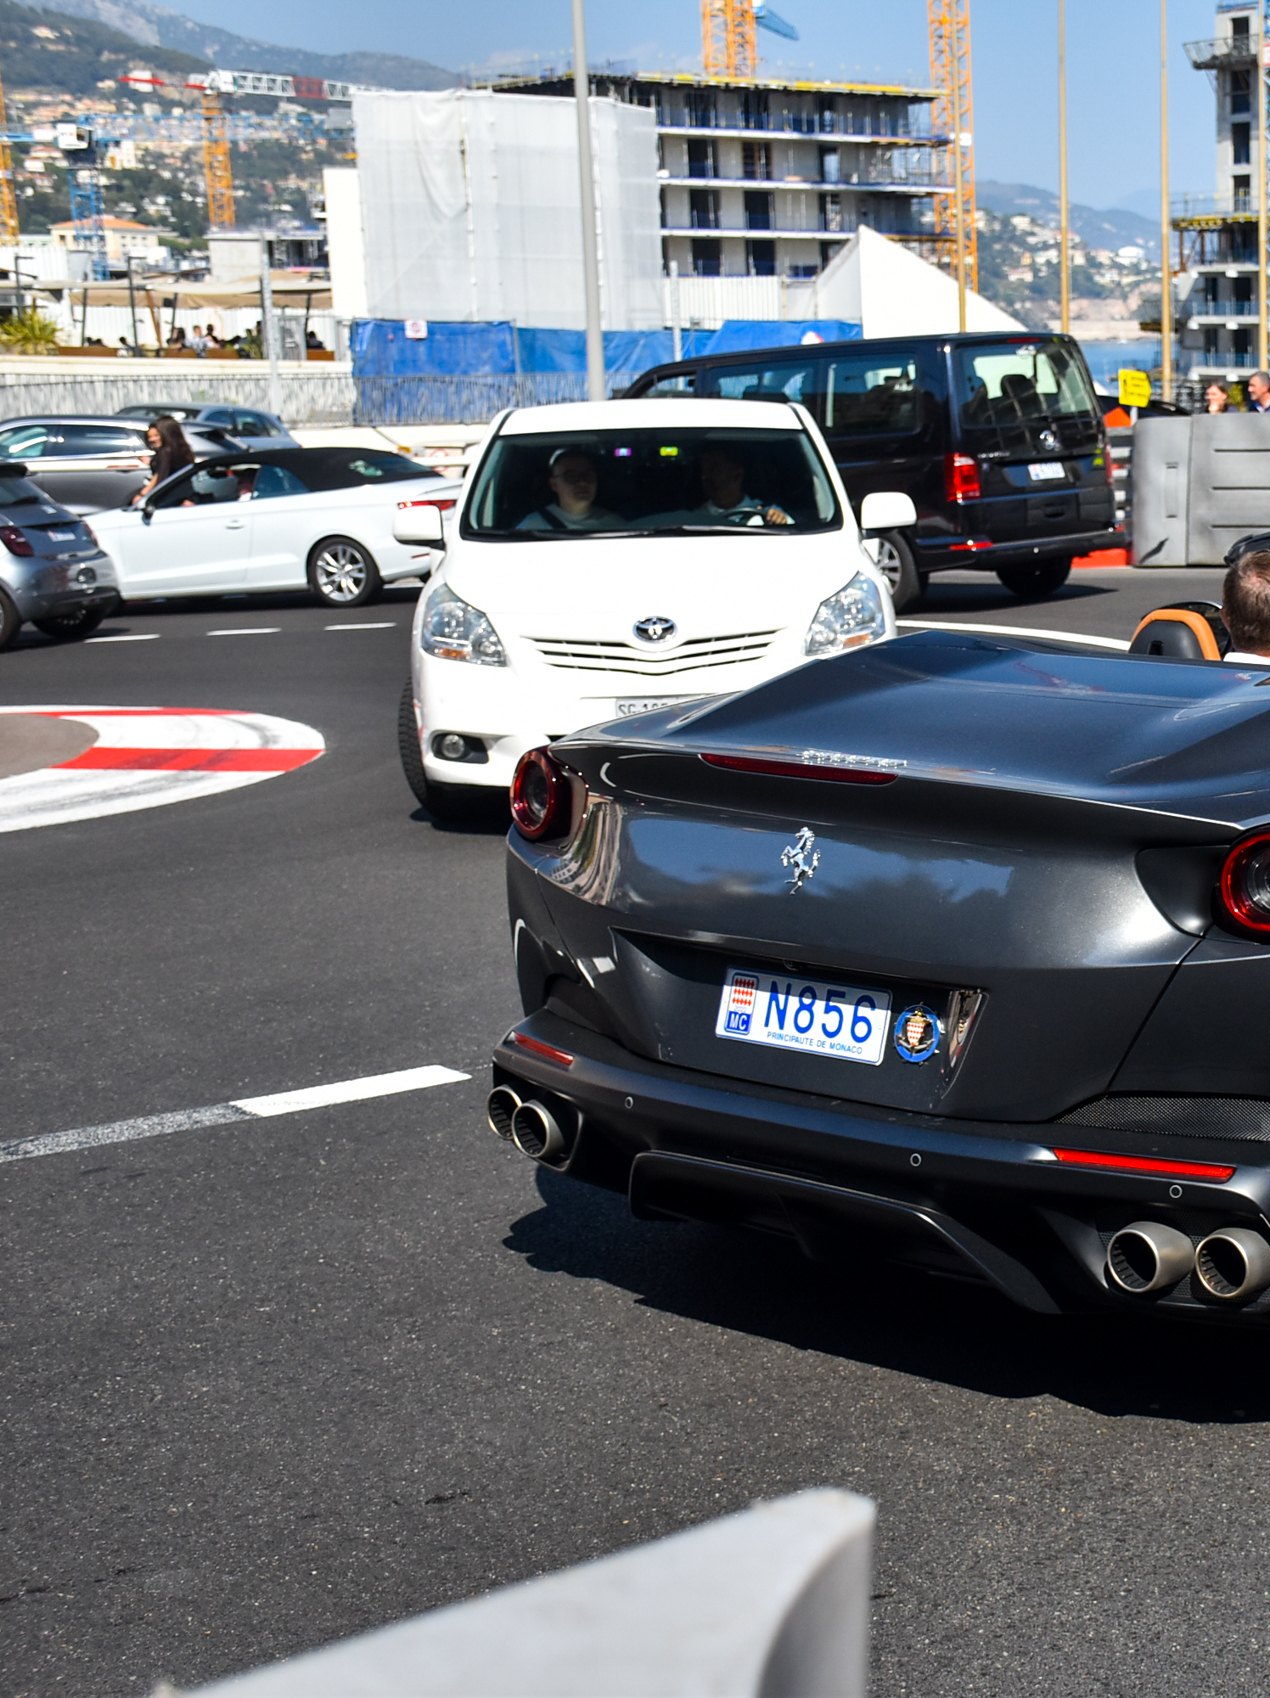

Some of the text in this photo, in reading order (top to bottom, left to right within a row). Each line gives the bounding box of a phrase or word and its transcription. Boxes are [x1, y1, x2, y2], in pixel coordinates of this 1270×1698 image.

[729, 1013, 748, 1030] MC
[764, 980, 876, 1043] N856
[767, 1031, 863, 1055] PRINCIPAUTE DE MONACO
